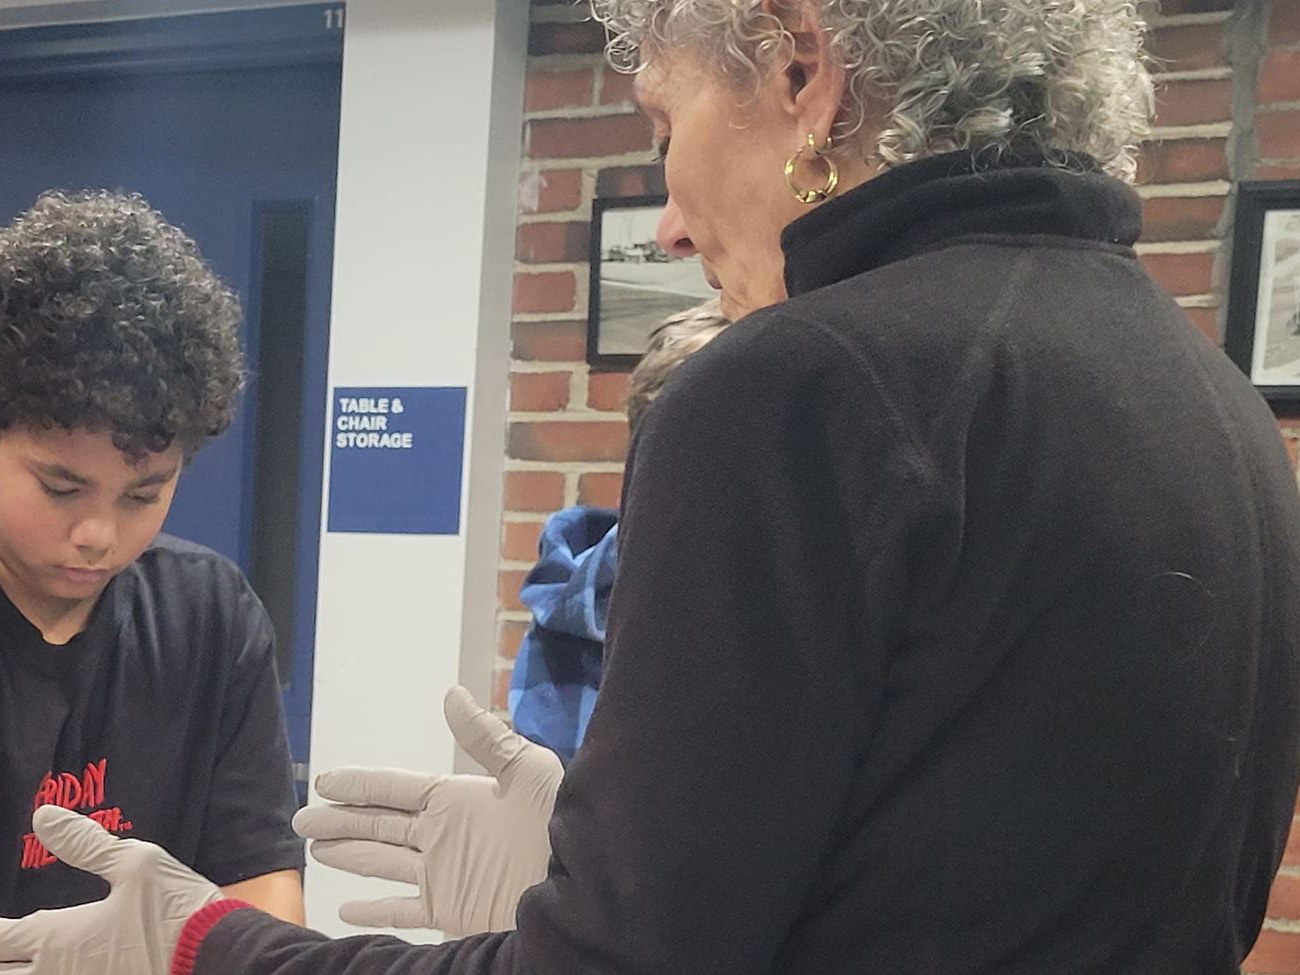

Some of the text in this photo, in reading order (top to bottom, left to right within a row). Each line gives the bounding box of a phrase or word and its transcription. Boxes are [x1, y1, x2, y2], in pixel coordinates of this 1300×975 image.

[339, 398, 404, 413] TABLE &
[337, 415, 388, 431] CHAIR
[336, 432, 413, 448] STORAGE
